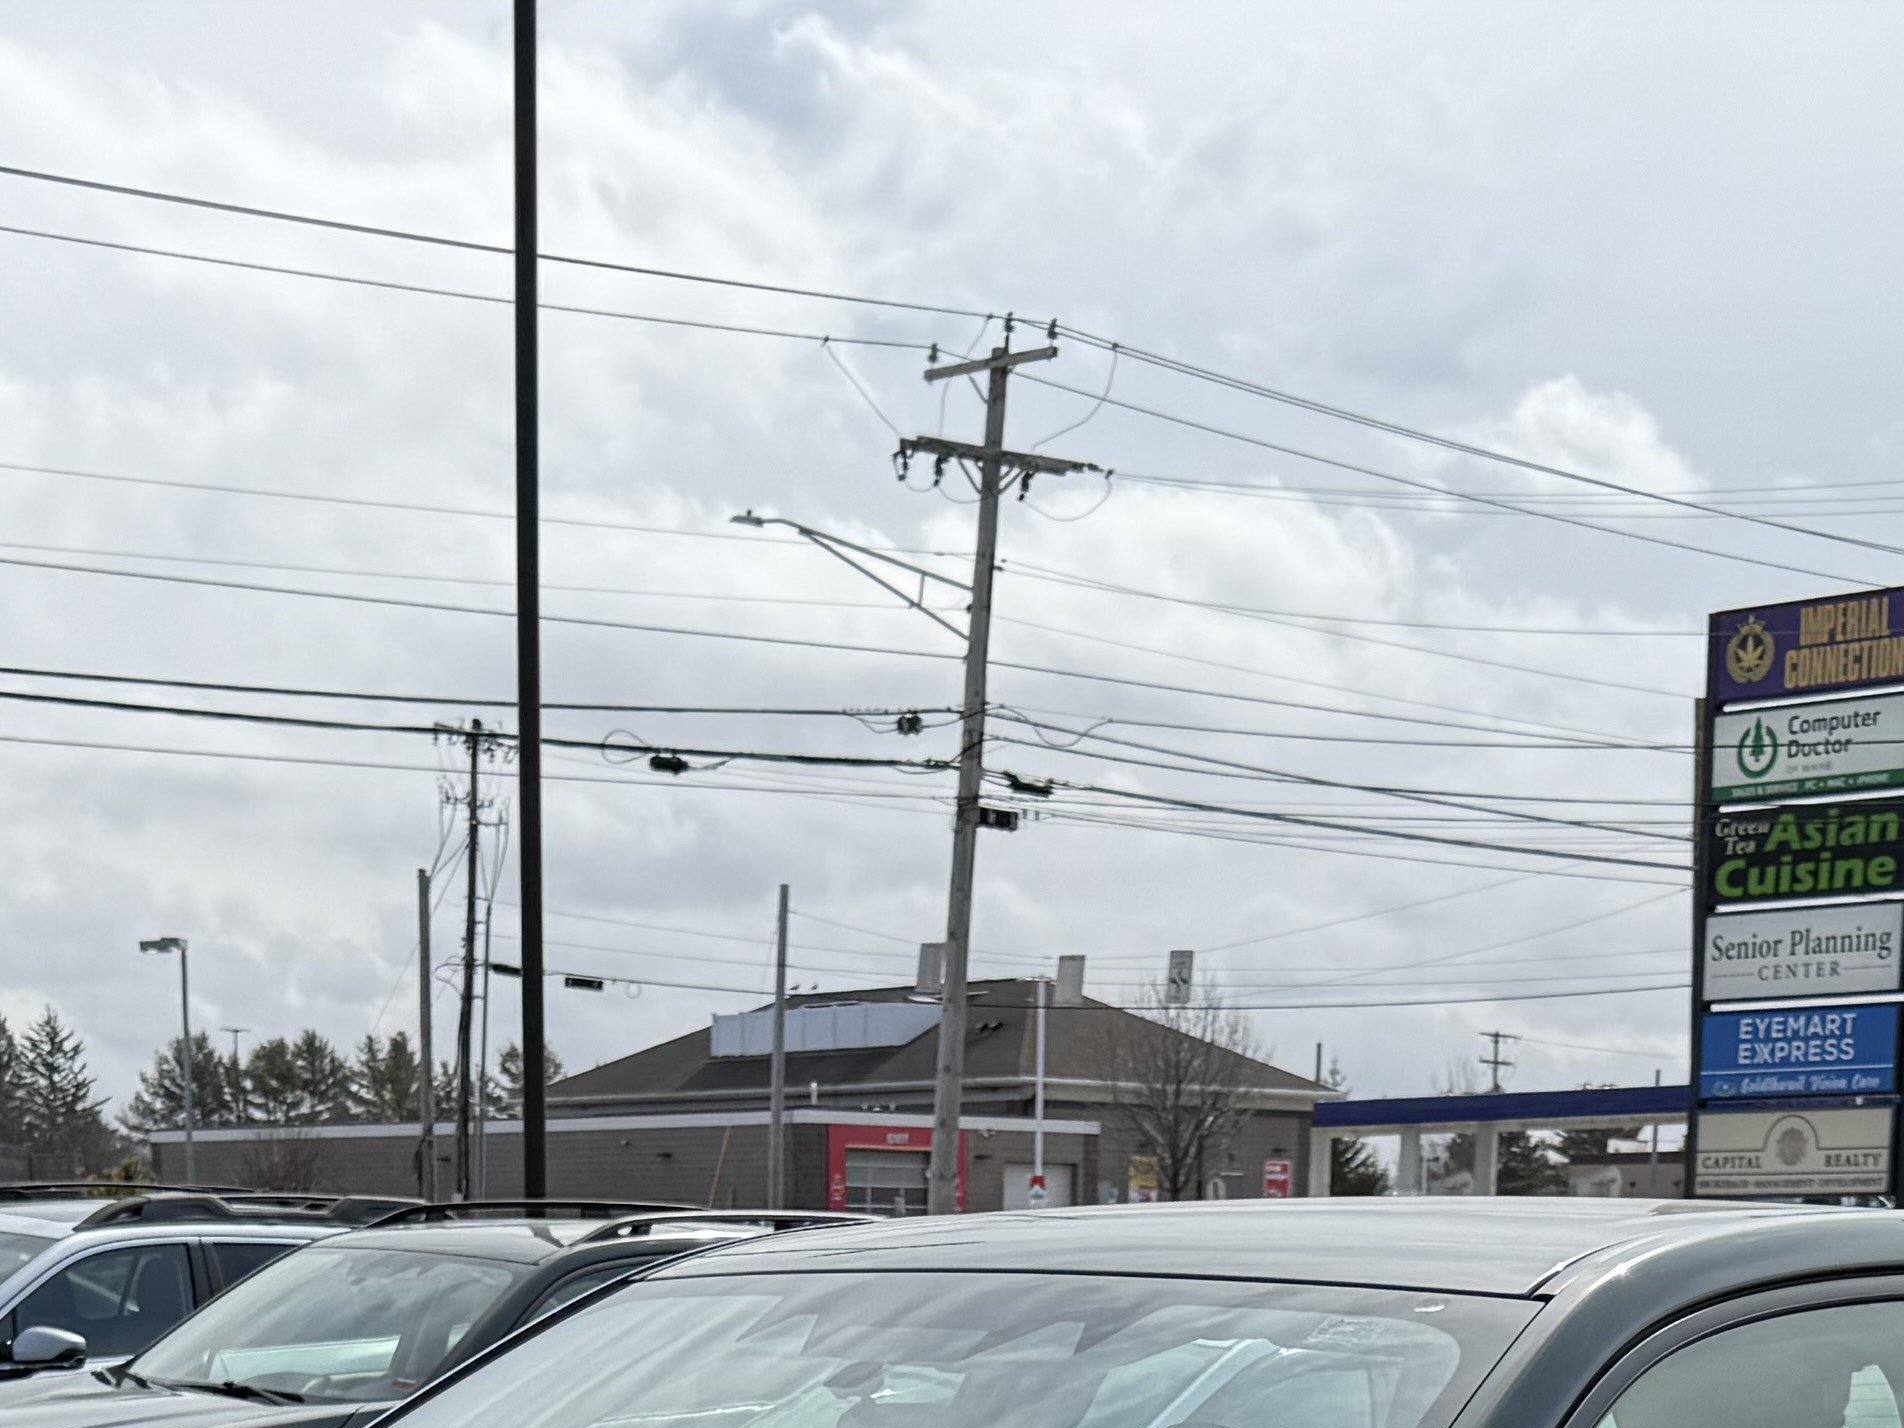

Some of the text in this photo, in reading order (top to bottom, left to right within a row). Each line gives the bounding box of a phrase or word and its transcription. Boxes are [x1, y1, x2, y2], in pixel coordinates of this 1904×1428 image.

[1799, 596, 1890, 647] IMPERIAL
[1787, 709, 1882, 736] Computer
[1786, 736, 1852, 759] Doctor
[1715, 818, 1771, 837] Green
[1763, 808, 1900, 852] Asian
[1723, 836, 1757, 856] Tea
[1714, 852, 1897, 898] Cuisine
[1710, 926, 1893, 963] Senior Planning
[1757, 961, 1841, 981] CENTER
[1738, 1013, 1857, 1040] EYEMART
[1737, 1038, 1856, 1065] EXPRESS
[1701, 1152, 1883, 1170] CAPITAL REALTY
